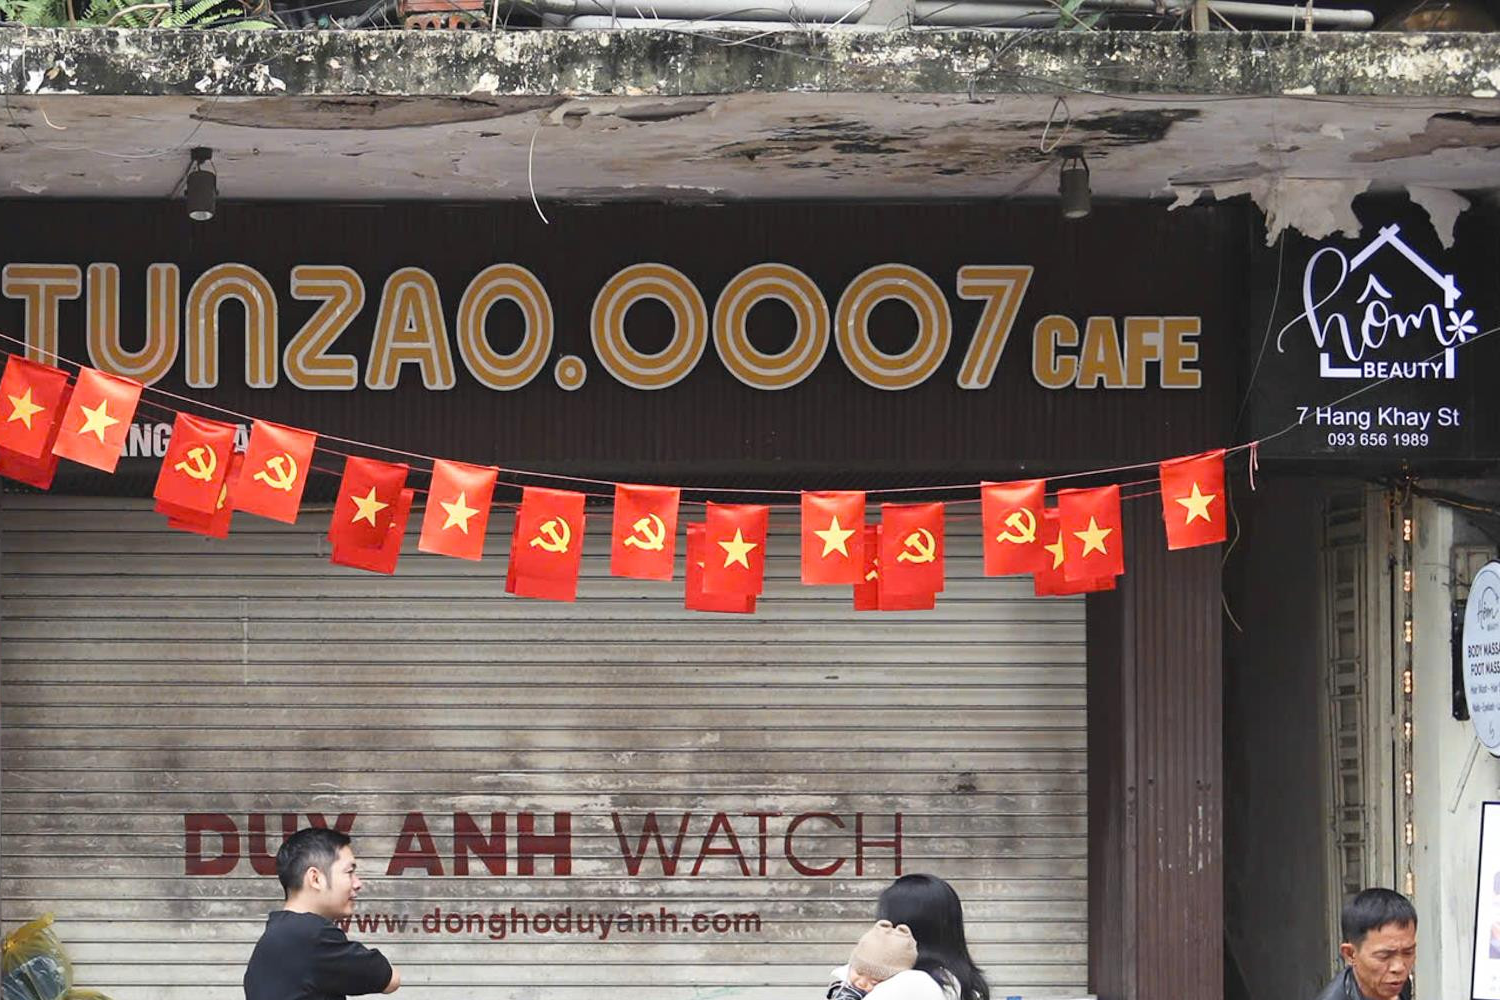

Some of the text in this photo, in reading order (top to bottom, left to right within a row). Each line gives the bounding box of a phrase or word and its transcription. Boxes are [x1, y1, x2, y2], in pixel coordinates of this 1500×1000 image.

[1032, 315, 1202, 389] CAFE
[1364, 362, 1443, 379] BEAUTY
[1297, 406, 1460, 430] 7 Hang Khay St
[1328, 432, 1429, 446] 093 656 1989
[386, 813, 572, 876] ANH
[610, 812, 902, 877] WATCH
